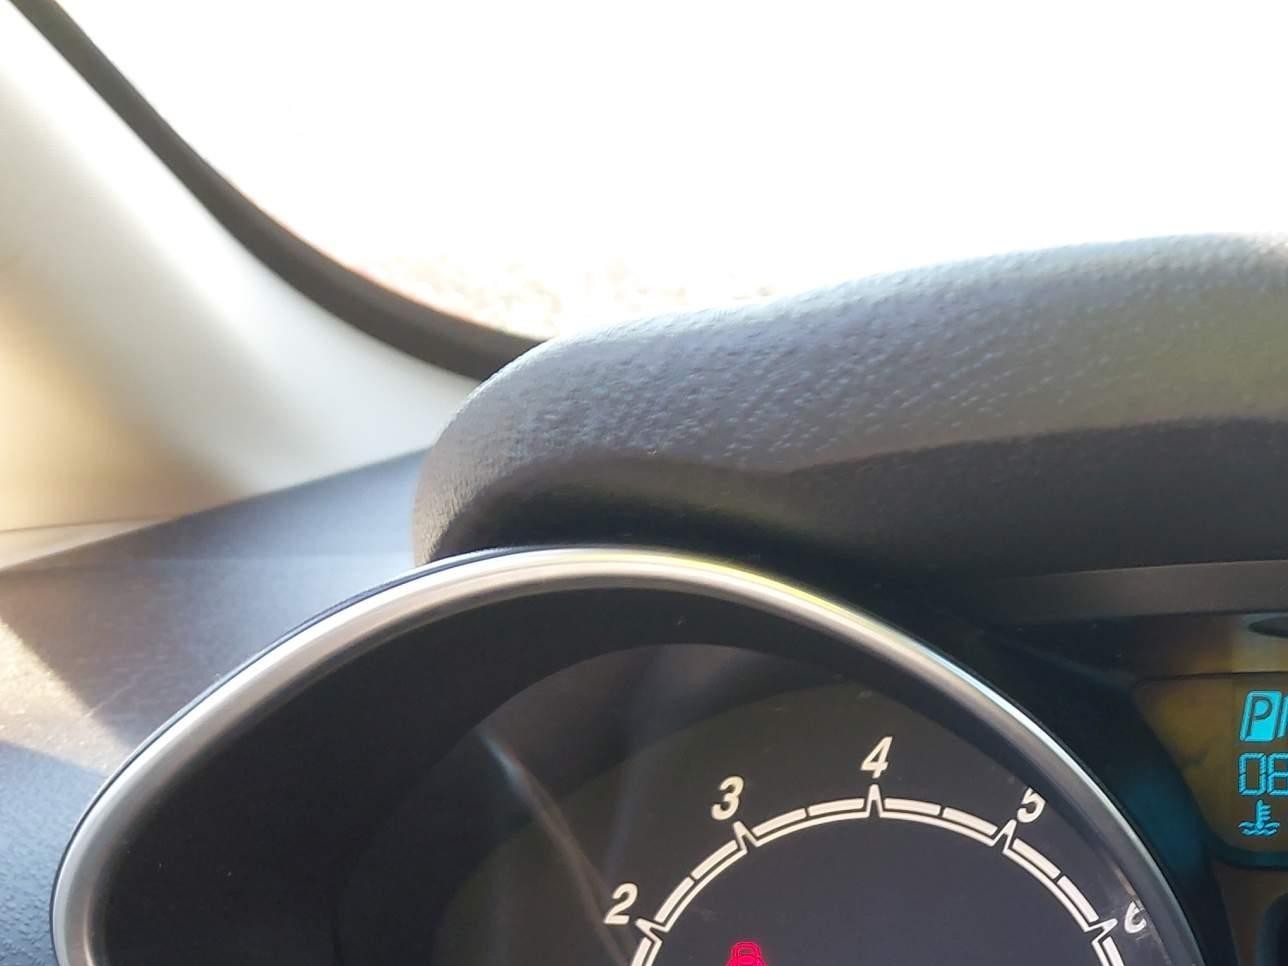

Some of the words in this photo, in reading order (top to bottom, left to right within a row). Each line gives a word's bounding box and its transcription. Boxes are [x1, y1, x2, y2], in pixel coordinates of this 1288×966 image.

[861, 736, 893, 779] 4
[711, 776, 745, 822] 3
[1016, 787, 1046, 823] 5
[603, 882, 640, 926] 2
